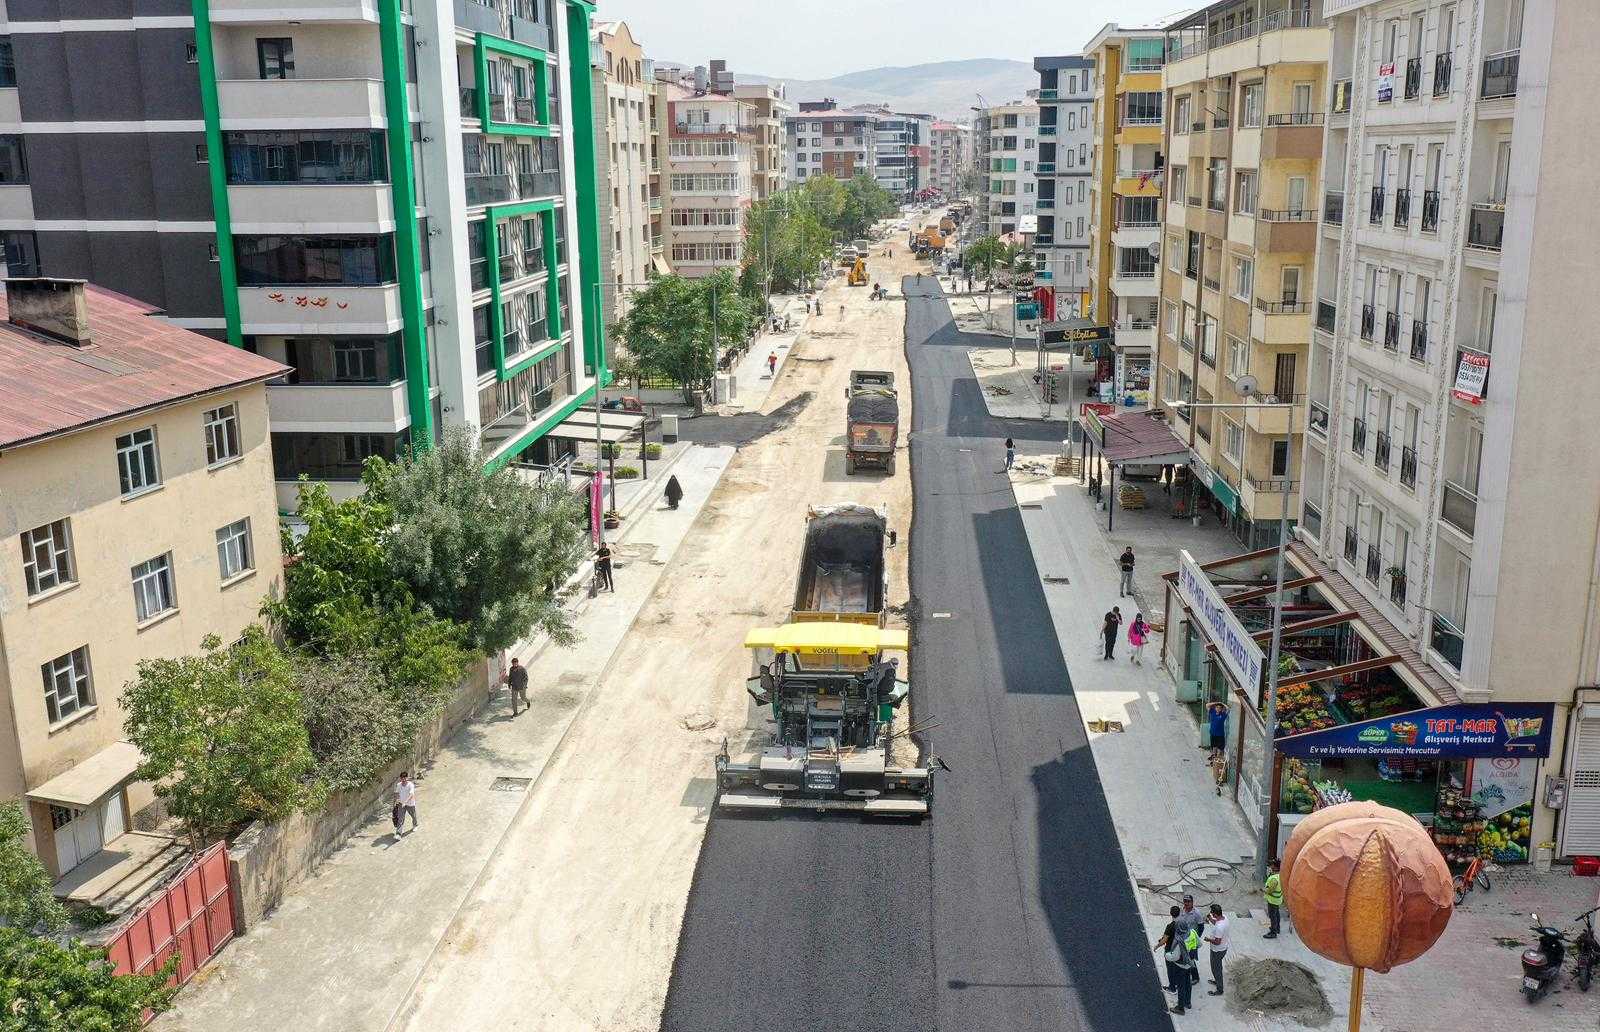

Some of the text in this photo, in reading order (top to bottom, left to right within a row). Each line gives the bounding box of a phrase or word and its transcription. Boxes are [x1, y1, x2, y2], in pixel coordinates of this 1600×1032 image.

[1425, 719, 1497, 734] TAT-MAR
[1424, 735, 1495, 745] Alışveriş Merkezi
[1310, 746, 1319, 754] Ev
[1329, 745, 1336, 755] İş
[1337, 746, 1367, 754] Yerlerine
[1368, 746, 1404, 754] Servisimiz
[1405, 746, 1441, 754] Mevcuttur
